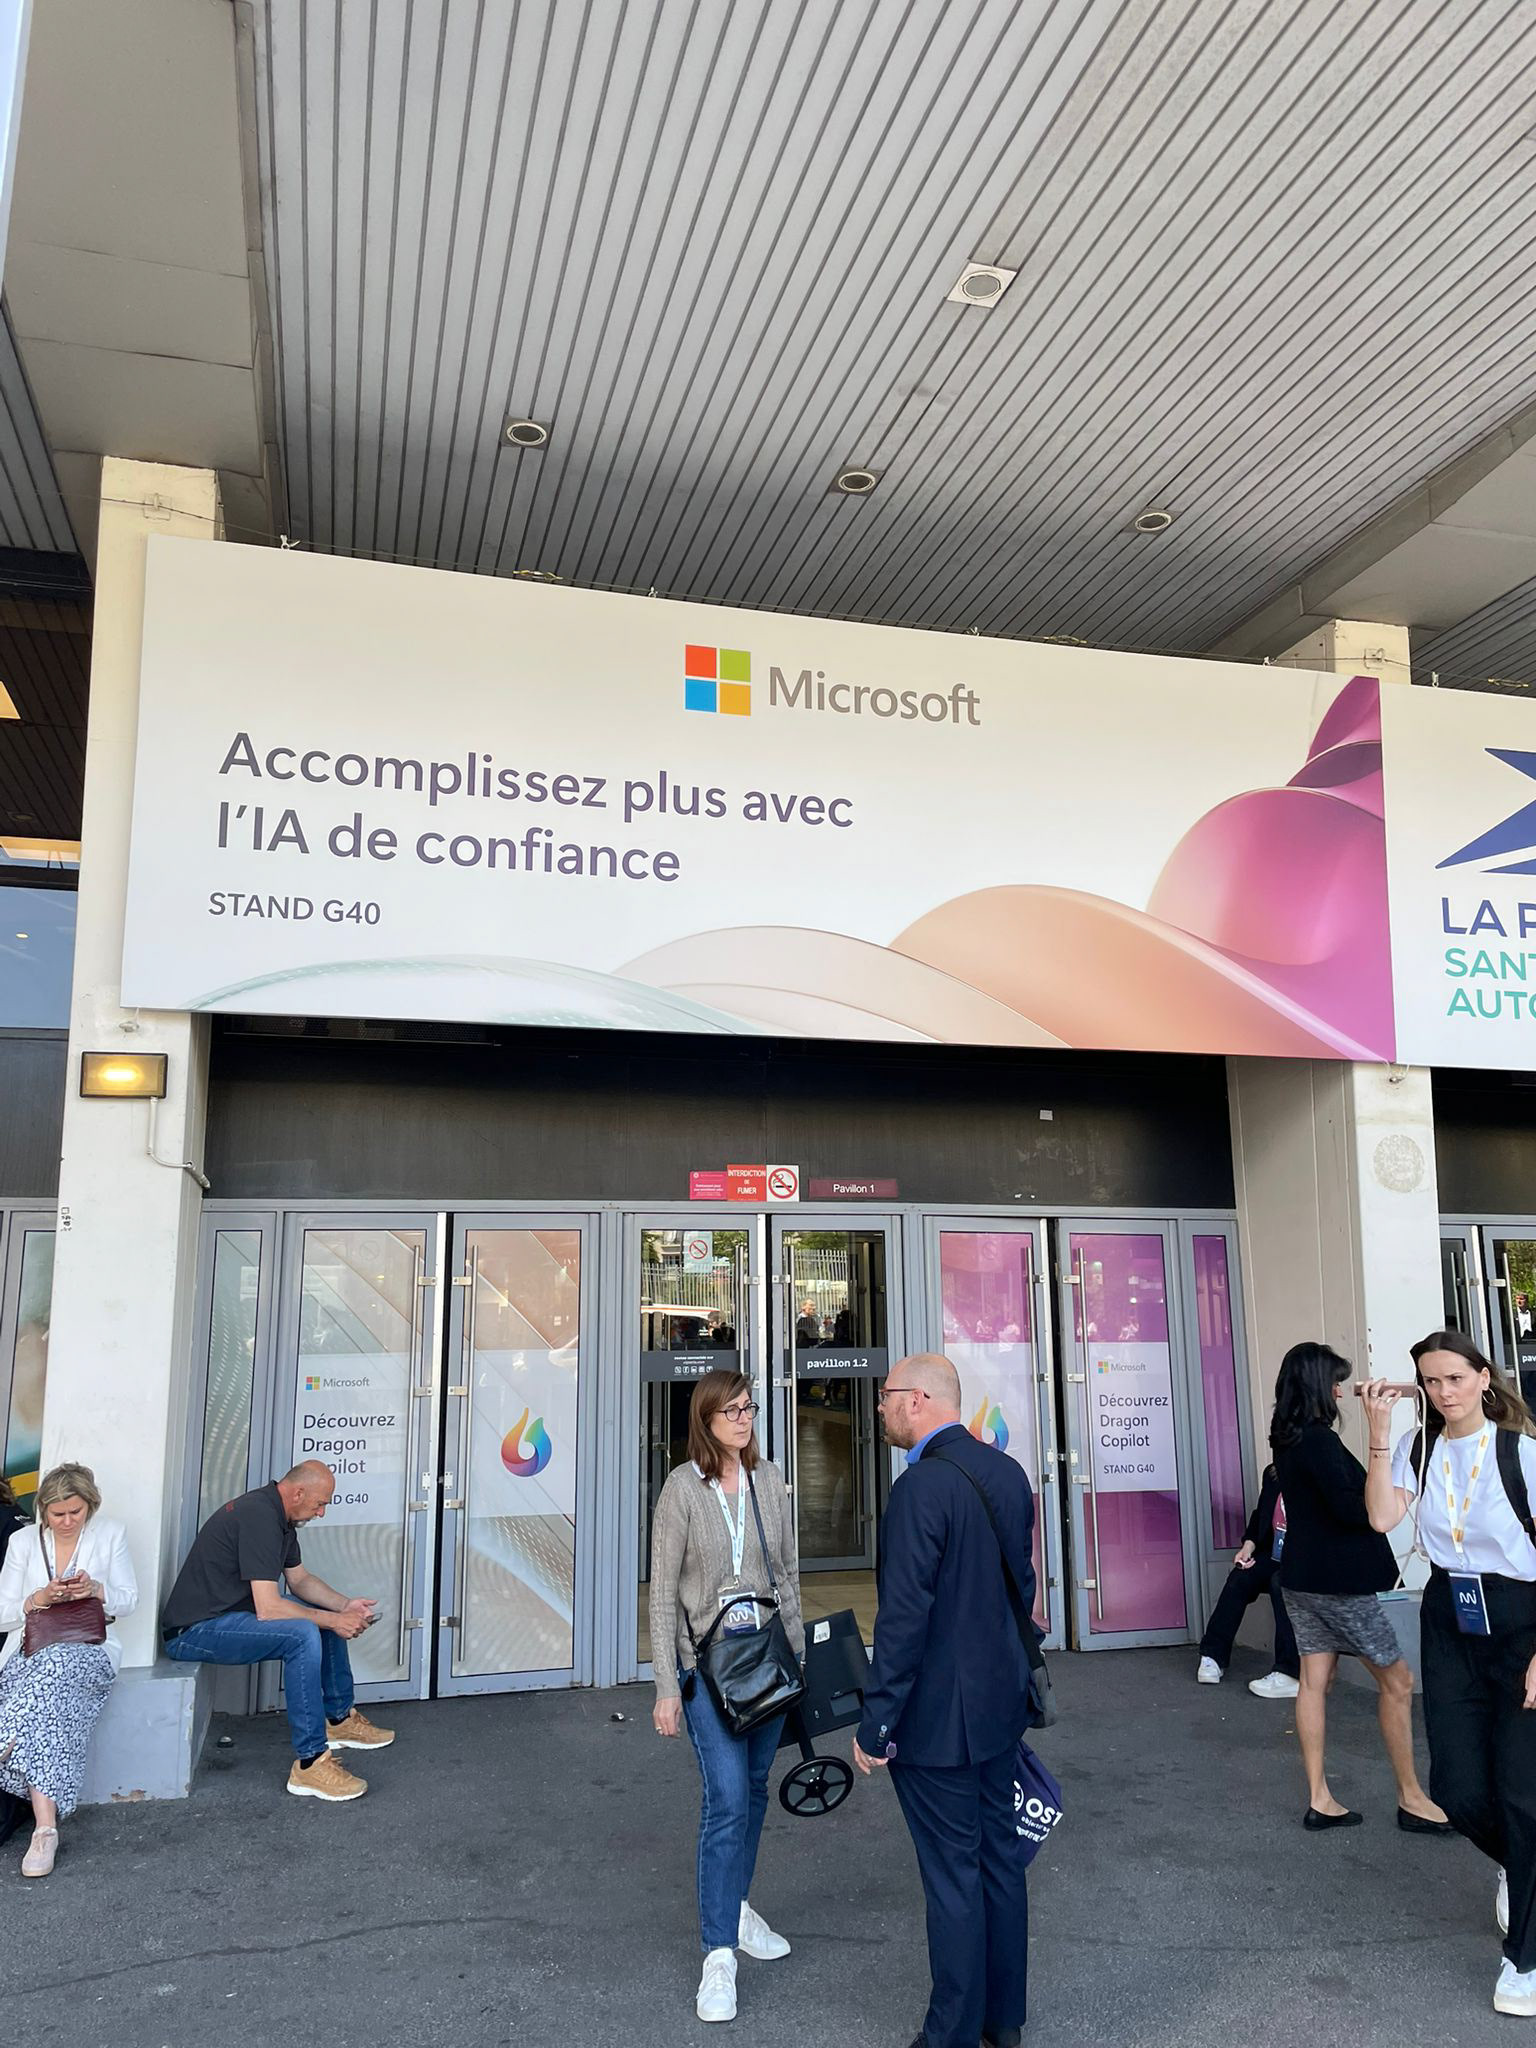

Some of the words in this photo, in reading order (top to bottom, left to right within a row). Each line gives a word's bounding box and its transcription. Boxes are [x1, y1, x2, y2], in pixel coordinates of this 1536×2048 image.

[770, 666, 981, 726] Microsoft
[218, 732, 607, 808] Accomplissez
[625, 771, 727, 823] plus
[743, 792, 853, 828] avec
[218, 801, 310, 854] l'IA
[329, 813, 398, 861] de
[417, 827, 680, 882] confiance
[208, 892, 314, 920] STAND
[323, 899, 382, 925] G40
[1441, 897, 1508, 937] LA
[1445, 947, 1536, 981] SAN
[1447, 988, 1536, 1020] AUT
[727, 1169, 766, 1177] INTERDICTION
[737, 1187, 757, 1195] FUMER
[833, 1184, 867, 1194] Pavillon
[869, 1184, 875, 1193] 1
[807, 1359, 850, 1370] pavillon
[852, 1358, 868, 1368] 1.2
[1110, 1362, 1146, 1372] Microsoft
[323, 1376, 370, 1388] Microsoft
[1099, 1393, 1169, 1407] Découvrez
[303, 1412, 396, 1430] Découvrez
[1100, 1414, 1149, 1430] Dragon
[302, 1437, 367, 1455] Dragon
[1100, 1433, 1150, 1450] Copilot
[327, 1458, 366, 1474] pilot
[1104, 1464, 1135, 1474] STAND
[1137, 1464, 1155, 1473] G40
[345, 1493, 369, 1504] G40
